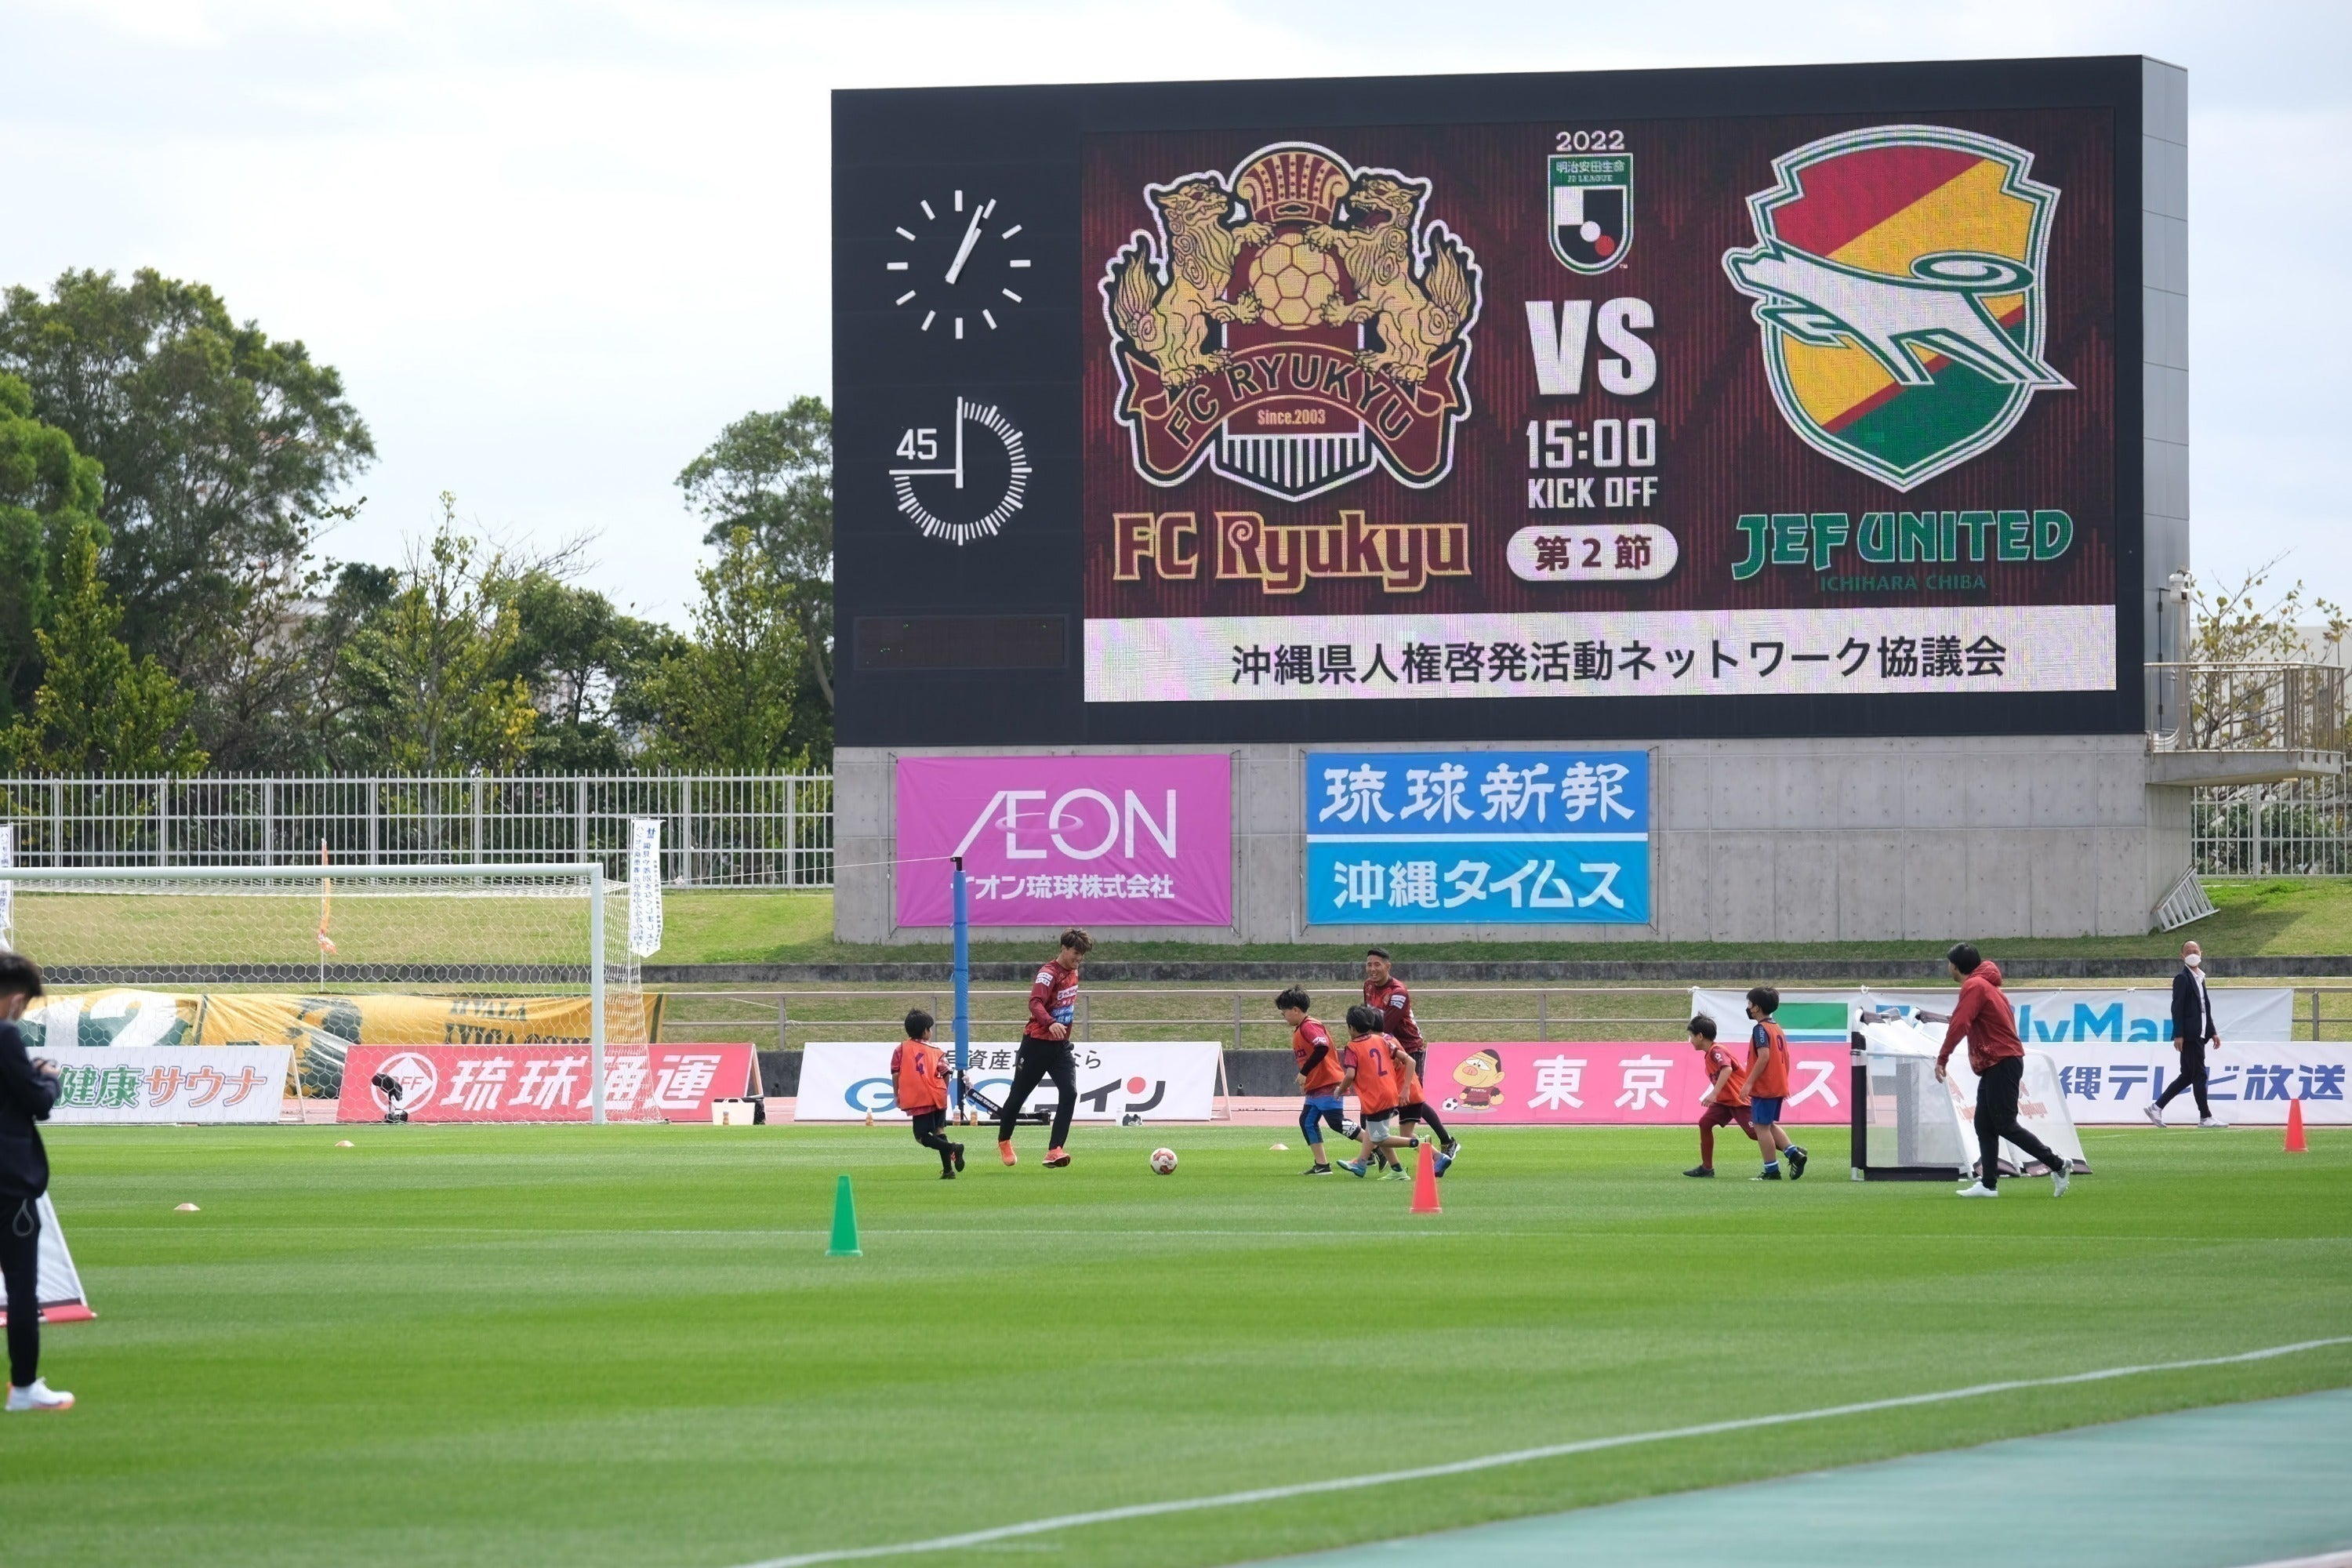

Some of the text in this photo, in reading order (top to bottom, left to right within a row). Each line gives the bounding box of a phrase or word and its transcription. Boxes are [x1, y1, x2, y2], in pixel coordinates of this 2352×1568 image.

[1555, 130, 1625, 151] 2022
[1555, 160, 1625, 173] 明治安田生命
[1525, 297, 1657, 396] VS
[1164, 353, 1414, 451] FC RYUKYU
[1257, 408, 1326, 426] Since.2003
[896, 428, 937, 460] 45
[1526, 418, 1656, 470] 15:00
[1528, 476, 1658, 509] KICK OFF
[1112, 510, 1472, 594] FC Ryukyu
[1534, 534, 1653, 572] 第2節
[1731, 510, 2074, 580] JEF UNITED
[1820, 574, 1987, 592] ICHIHARA CHIBA
[1231, 633, 2008, 686] 沖縄県人権啓発活動ネットワーク協議会
[1319, 761, 1636, 824] 琉球新報
[1333, 859, 1625, 909] 沖縄タイムス
[439, 1054, 722, 1111] 琉球通運
[1369, 1047, 1388, 1077] 2
[1527, 1054, 1839, 1110] 東京ス
[2032, 1064, 2346, 1101] 縄テレビ放送
[52, 1064, 267, 1109] 健康サウナ
